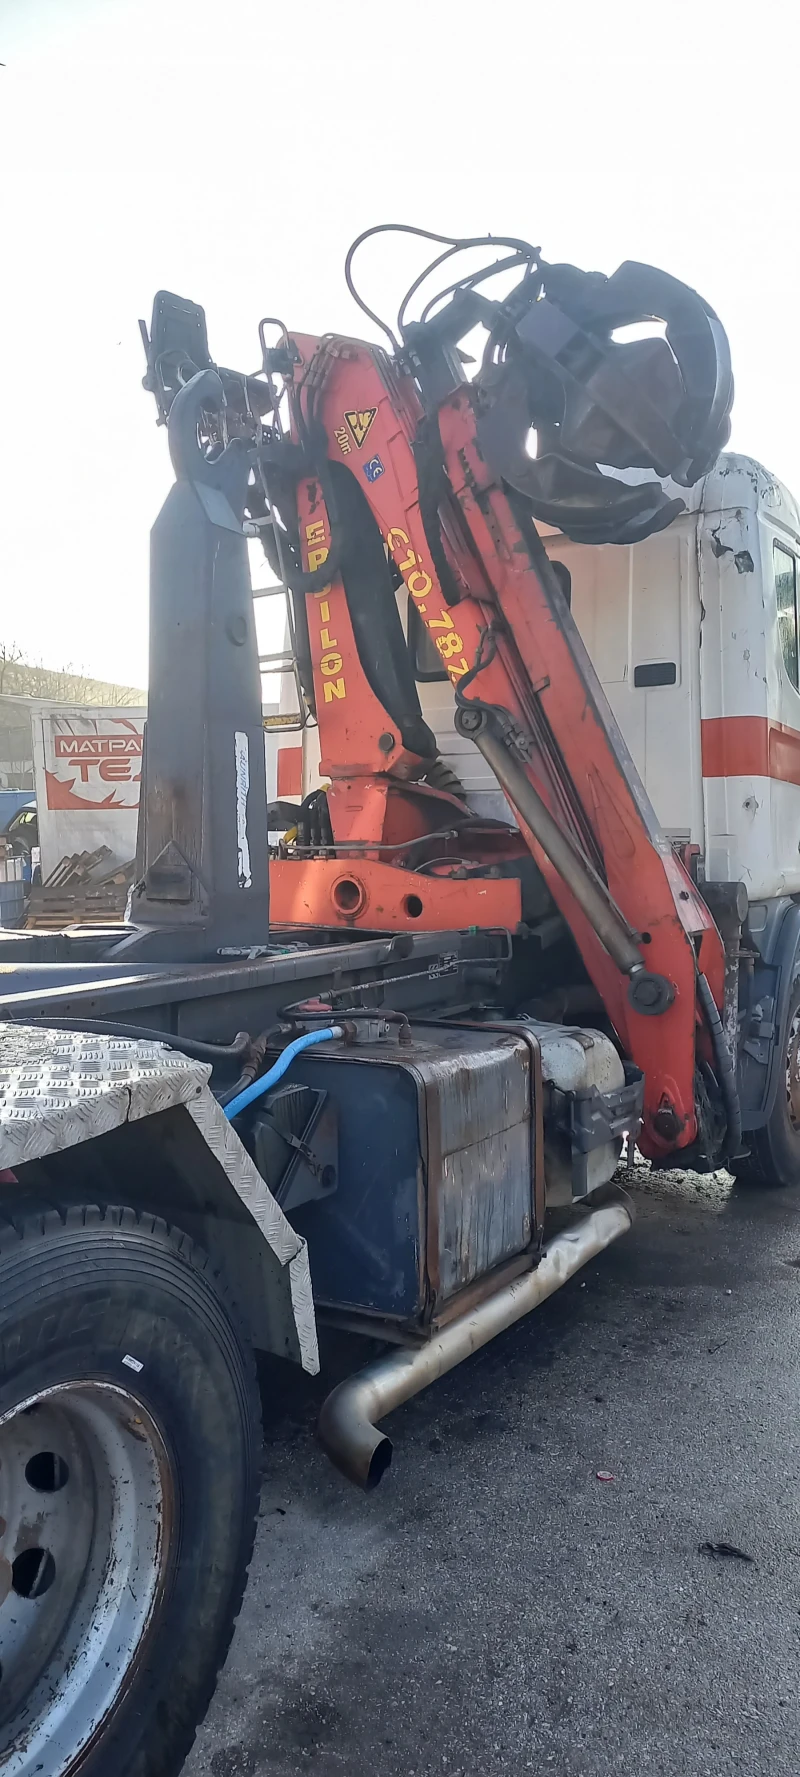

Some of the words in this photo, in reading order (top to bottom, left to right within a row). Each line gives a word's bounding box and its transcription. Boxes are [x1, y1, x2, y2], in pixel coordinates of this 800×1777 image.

[334, 427, 352, 455] 20m
[369, 459, 383, 478] CE
[60, 738, 143, 753] MATPA
